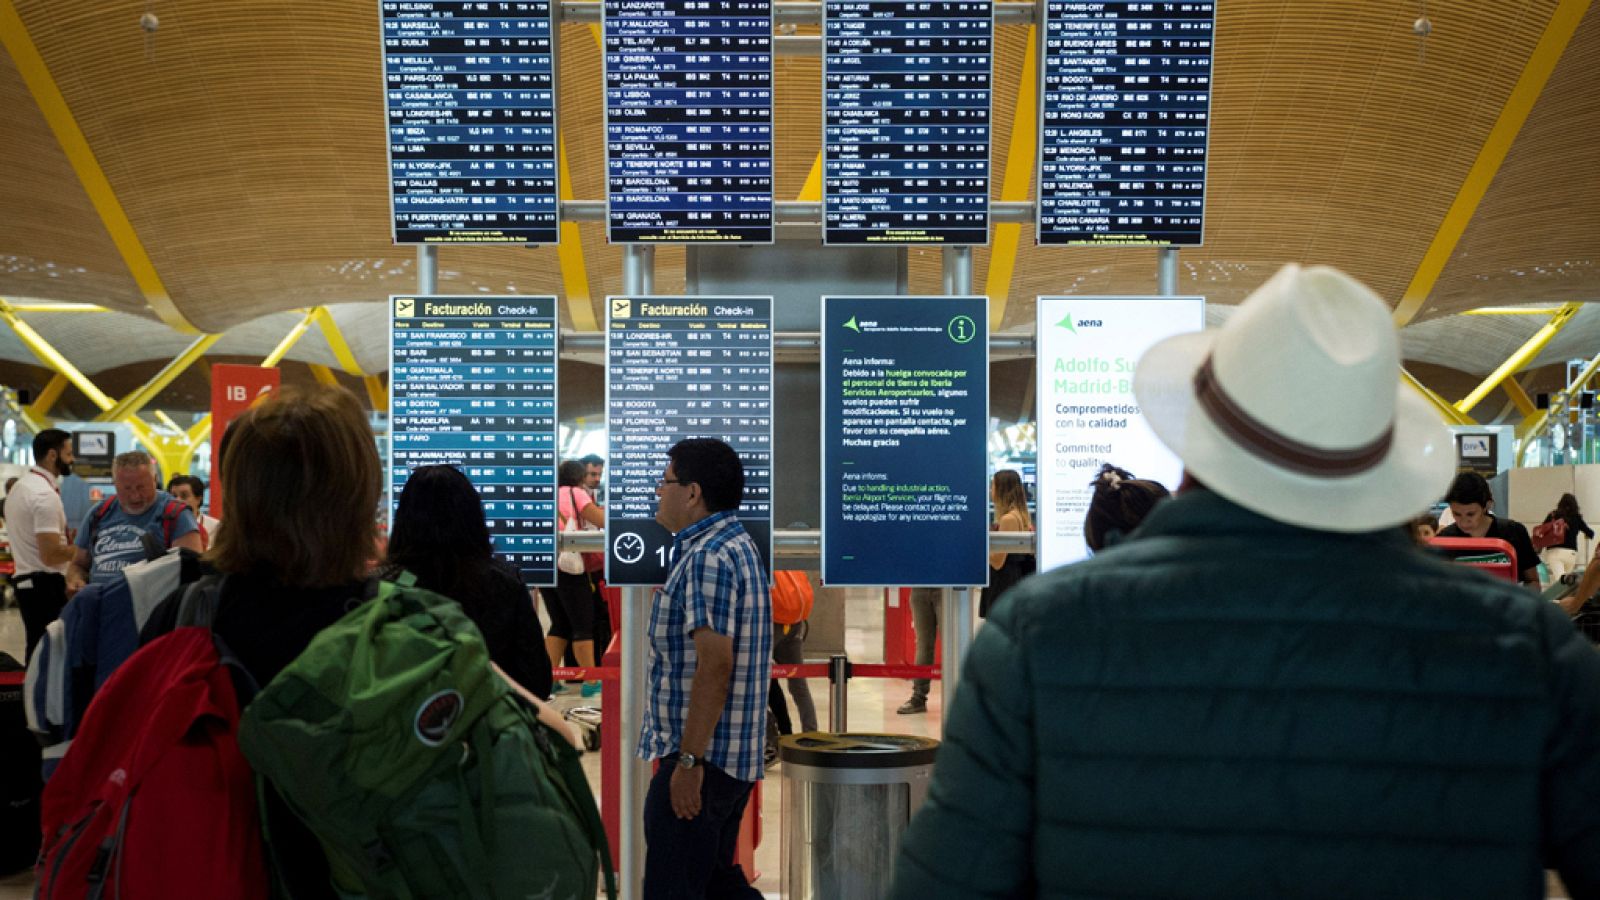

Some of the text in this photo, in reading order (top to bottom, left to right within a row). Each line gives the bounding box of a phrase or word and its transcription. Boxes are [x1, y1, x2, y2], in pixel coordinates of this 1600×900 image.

[425, 302, 538, 315] Facturación Check-in
[641, 303, 754, 316] Facturación Check-in
[1077, 319, 1103, 327] aena
[1054, 357, 1109, 373] Adolfo
[842, 369, 869, 377] Debido
[877, 369, 884, 377] la
[886, 369, 911, 378] huelga
[913, 369, 952, 377] convocada
[953, 371, 967, 379] por
[842, 379, 952, 388] el personal de tierra de Iberia
[227, 385, 248, 401] IB
[938, 389, 967, 398] algunos
[869, 399, 897, 407] pueden
[1055, 404, 1140, 416] Comprometidos
[885, 418, 915, 426] pantalla
[1055, 418, 1127, 428] con la calidad
[842, 427, 863, 435] favor
[873, 439, 899, 448] gracias
[1056, 443, 1112, 453] Committed
[1056, 458, 1065, 467] to
[842, 472, 860, 480] Aena
[867, 484, 895, 493] handling
[896, 484, 927, 492] industrial
[862, 494, 886, 503] Airport
[917, 495, 932, 503] your
[934, 494, 951, 503] flight
[953, 495, 967, 503] may
[855, 514, 887, 522] apologize
